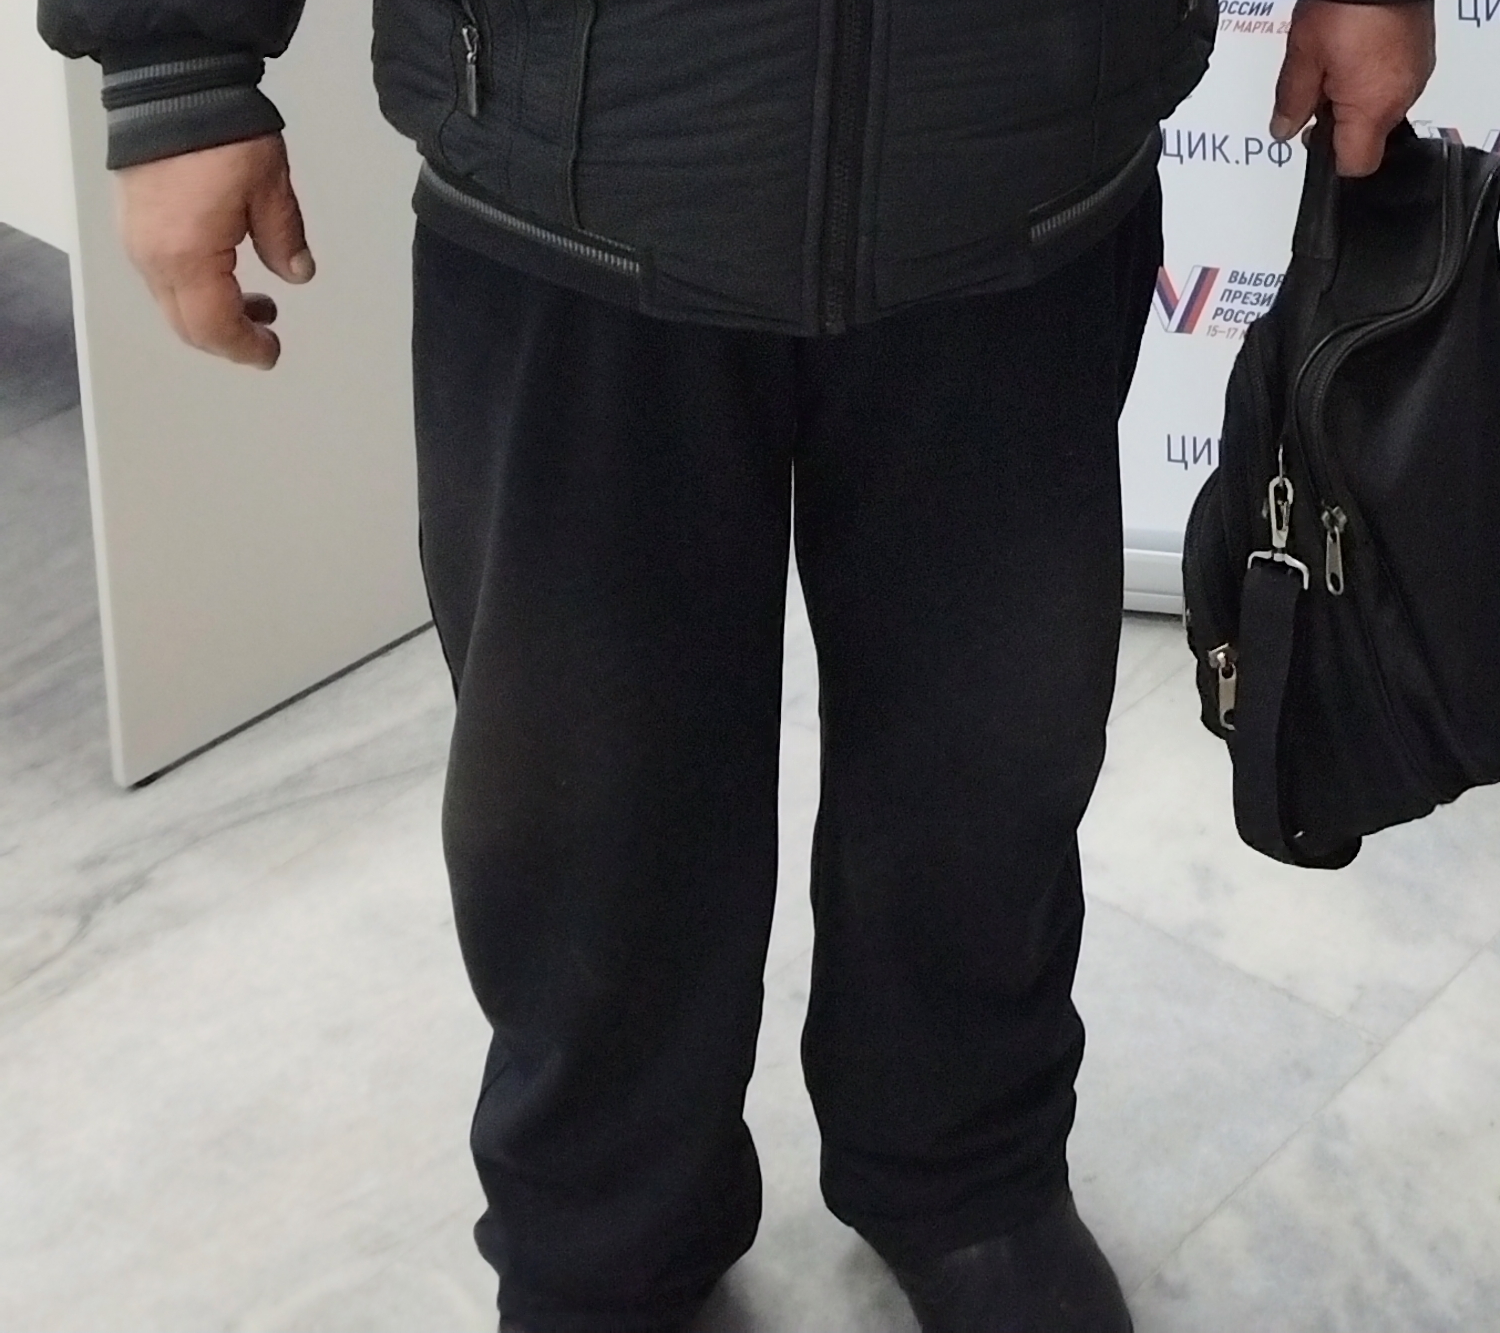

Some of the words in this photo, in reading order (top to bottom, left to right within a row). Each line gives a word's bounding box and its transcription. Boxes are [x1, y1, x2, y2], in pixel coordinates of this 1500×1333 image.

[1219, 0, 1274, 16] ОССИИ
[1233, 19, 1274, 33] МАРТА
[1162, 128, 1293, 167] ЦИК.РФ
